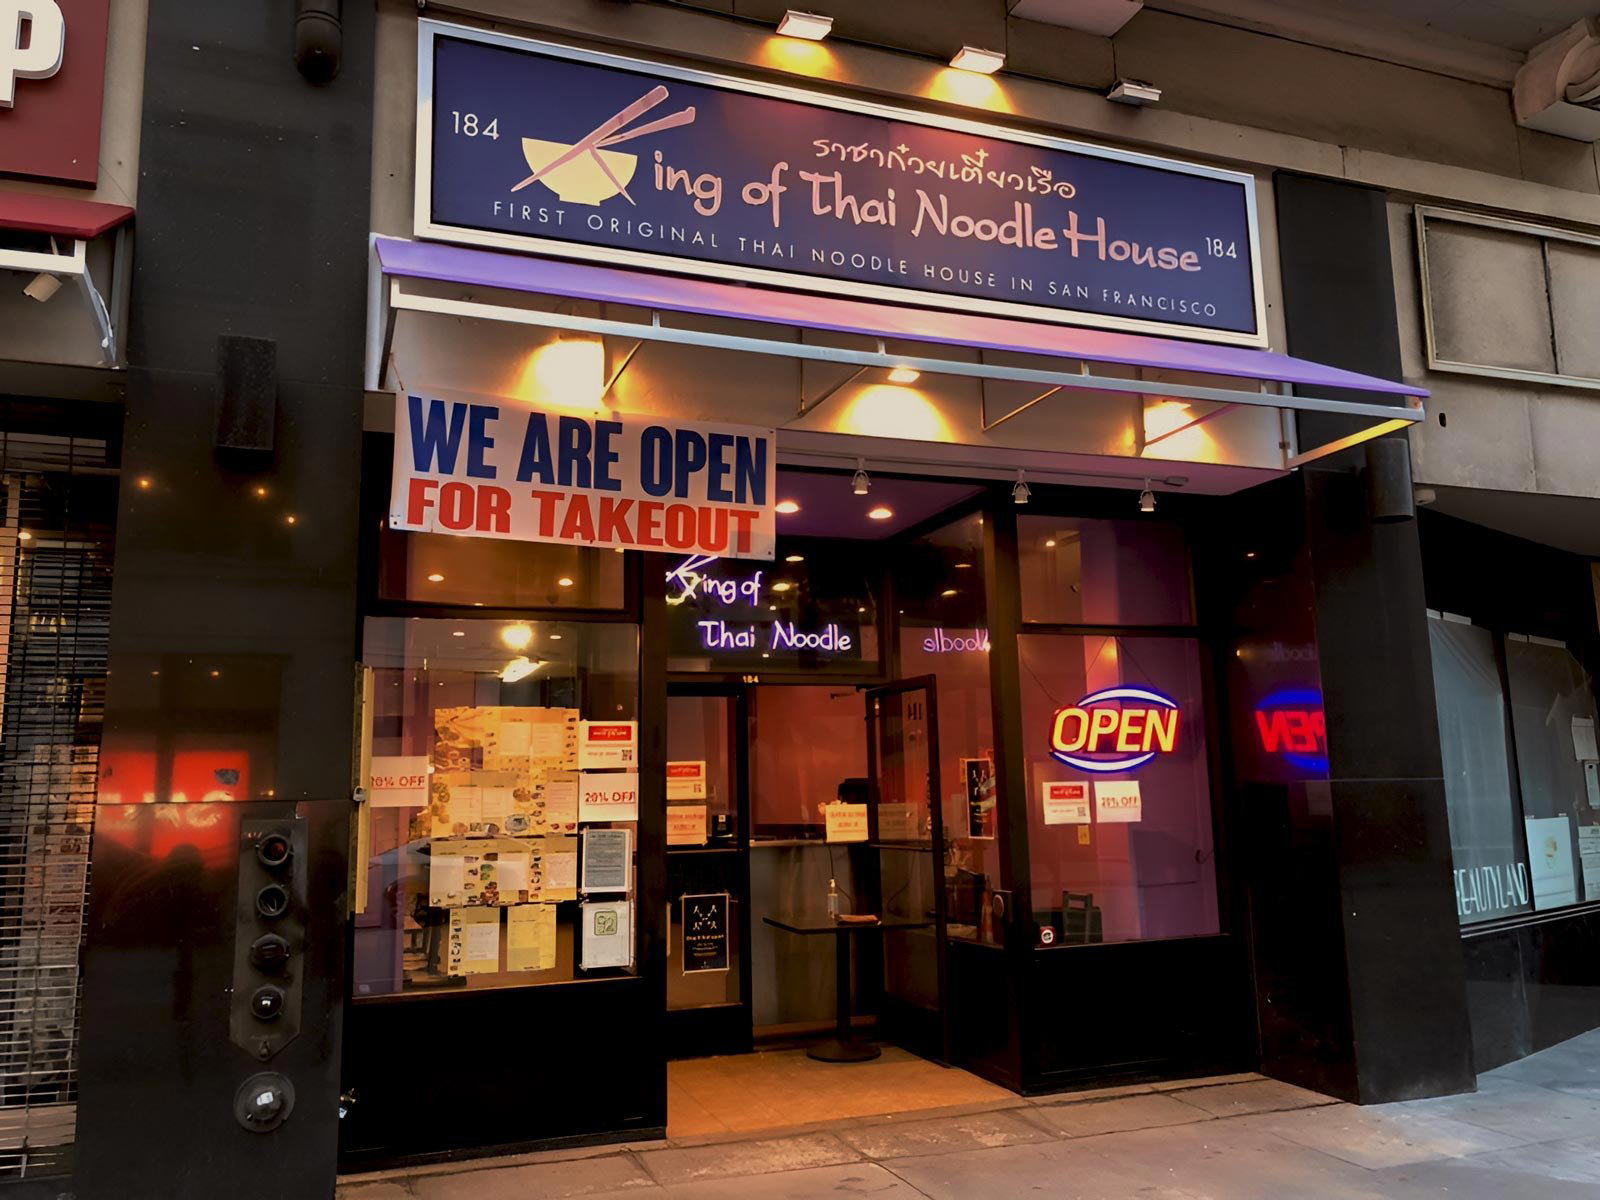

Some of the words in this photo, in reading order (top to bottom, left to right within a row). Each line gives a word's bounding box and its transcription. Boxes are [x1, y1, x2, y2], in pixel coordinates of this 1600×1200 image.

[452, 111, 499, 140] 184
[742, 162, 789, 228] of
[799, 171, 897, 227] Thai
[911, 189, 1059, 250] Noodle
[1063, 211, 1202, 272] House
[494, 201, 566, 226] FIRST
[588, 214, 720, 249] ORIGINAL
[739, 238, 794, 260] THAI
[812, 249, 908, 275] NOODLE
[924, 264, 996, 288] HOUSE
[1012, 277, 1034, 292] IN
[1049, 281, 1090, 300] SAN
[1103, 289, 1217, 318] FRANCISCO
[1205, 237, 1238, 259] 184
[408, 396, 499, 479] WE
[516, 412, 623, 492] ARE
[641, 425, 767, 506] OPEN
[407, 477, 512, 534] FOR
[532, 489, 760, 553] TAKEOUT
[741, 571, 763, 606] of
[698, 620, 755, 649] Thai
[771, 619, 852, 650] Noodle
[1052, 708, 1179, 752] OPEN
[399, 776, 425, 787] OFF
